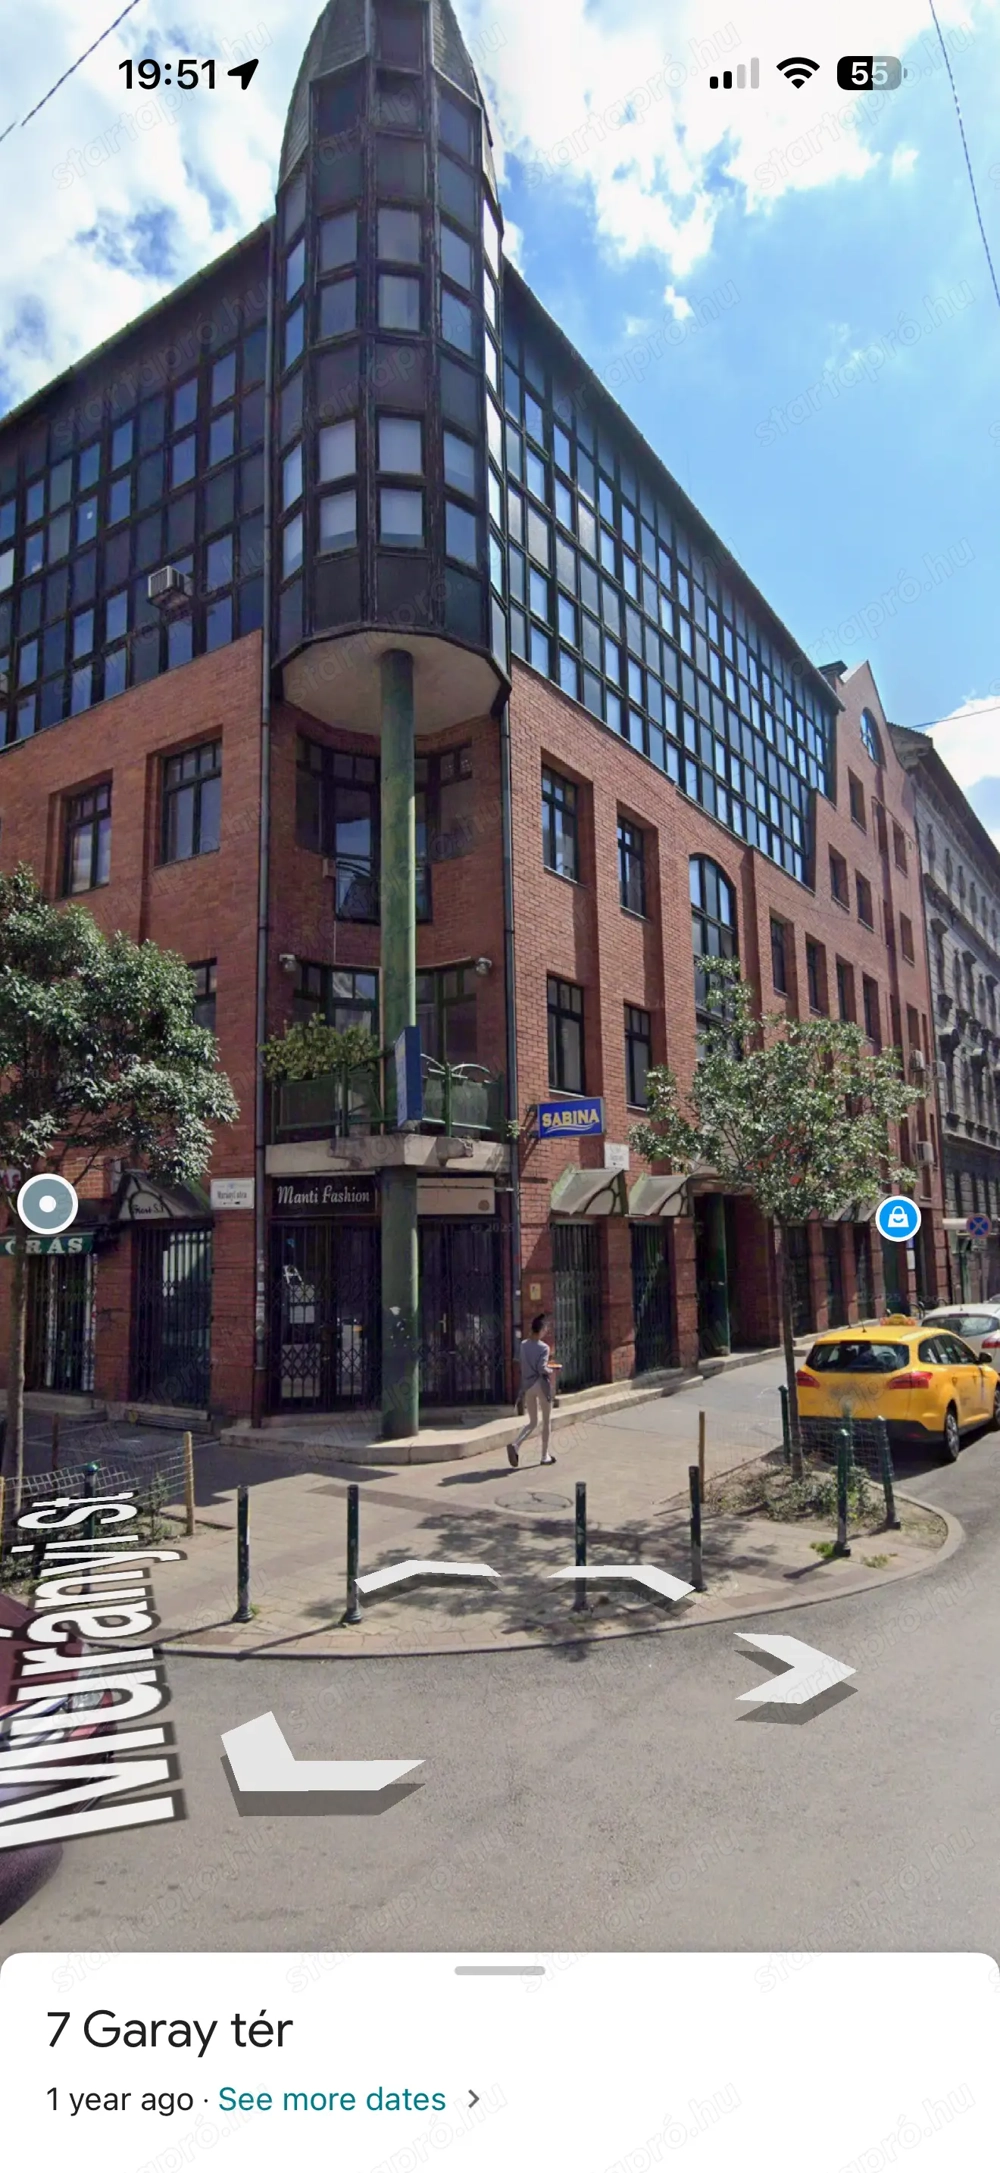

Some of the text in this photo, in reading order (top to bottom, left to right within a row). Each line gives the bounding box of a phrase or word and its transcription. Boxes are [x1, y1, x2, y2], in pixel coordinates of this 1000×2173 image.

[542, 1108, 600, 1127] SABINA
[277, 1185, 370, 1204] Manti Fashion
